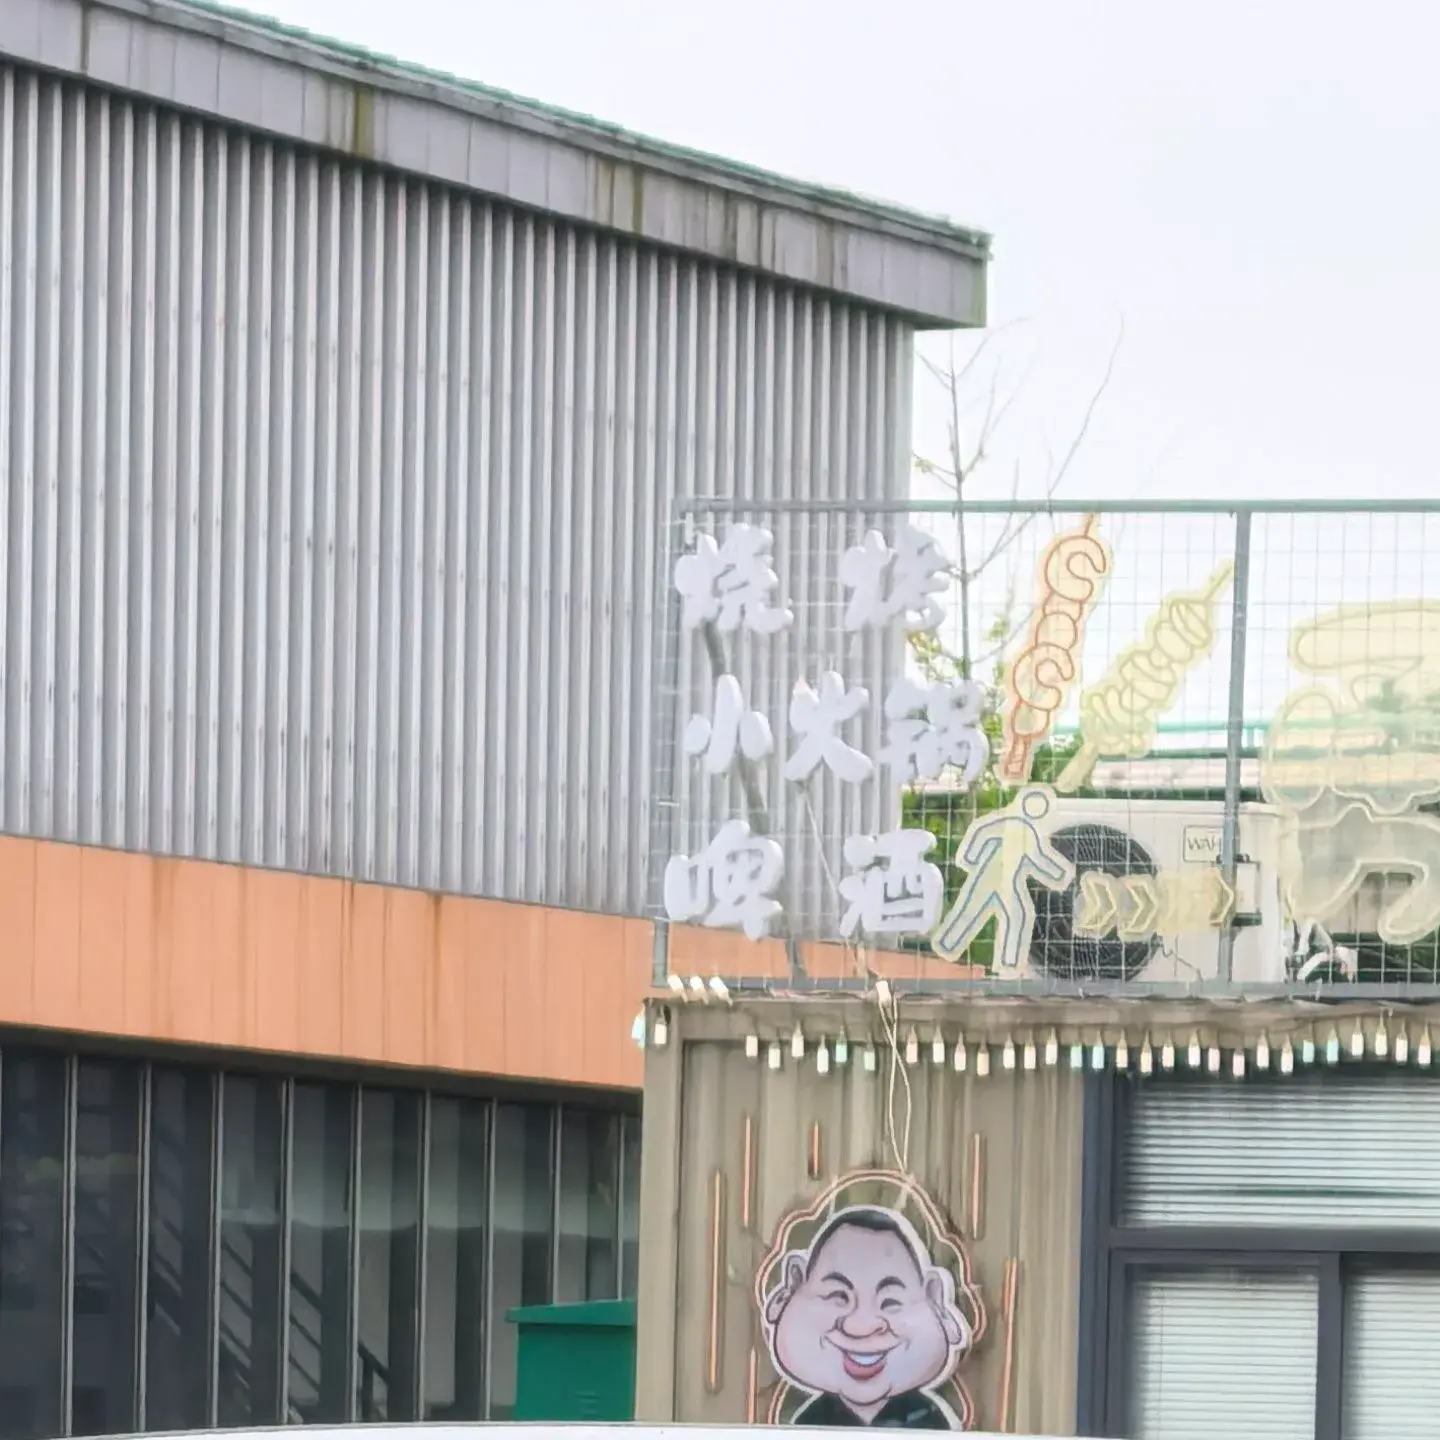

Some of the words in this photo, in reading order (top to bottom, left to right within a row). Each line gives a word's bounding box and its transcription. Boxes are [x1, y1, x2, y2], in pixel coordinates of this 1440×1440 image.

[684, 670, 988, 785] 小火锅
[664, 819, 944, 940] 啤酒
